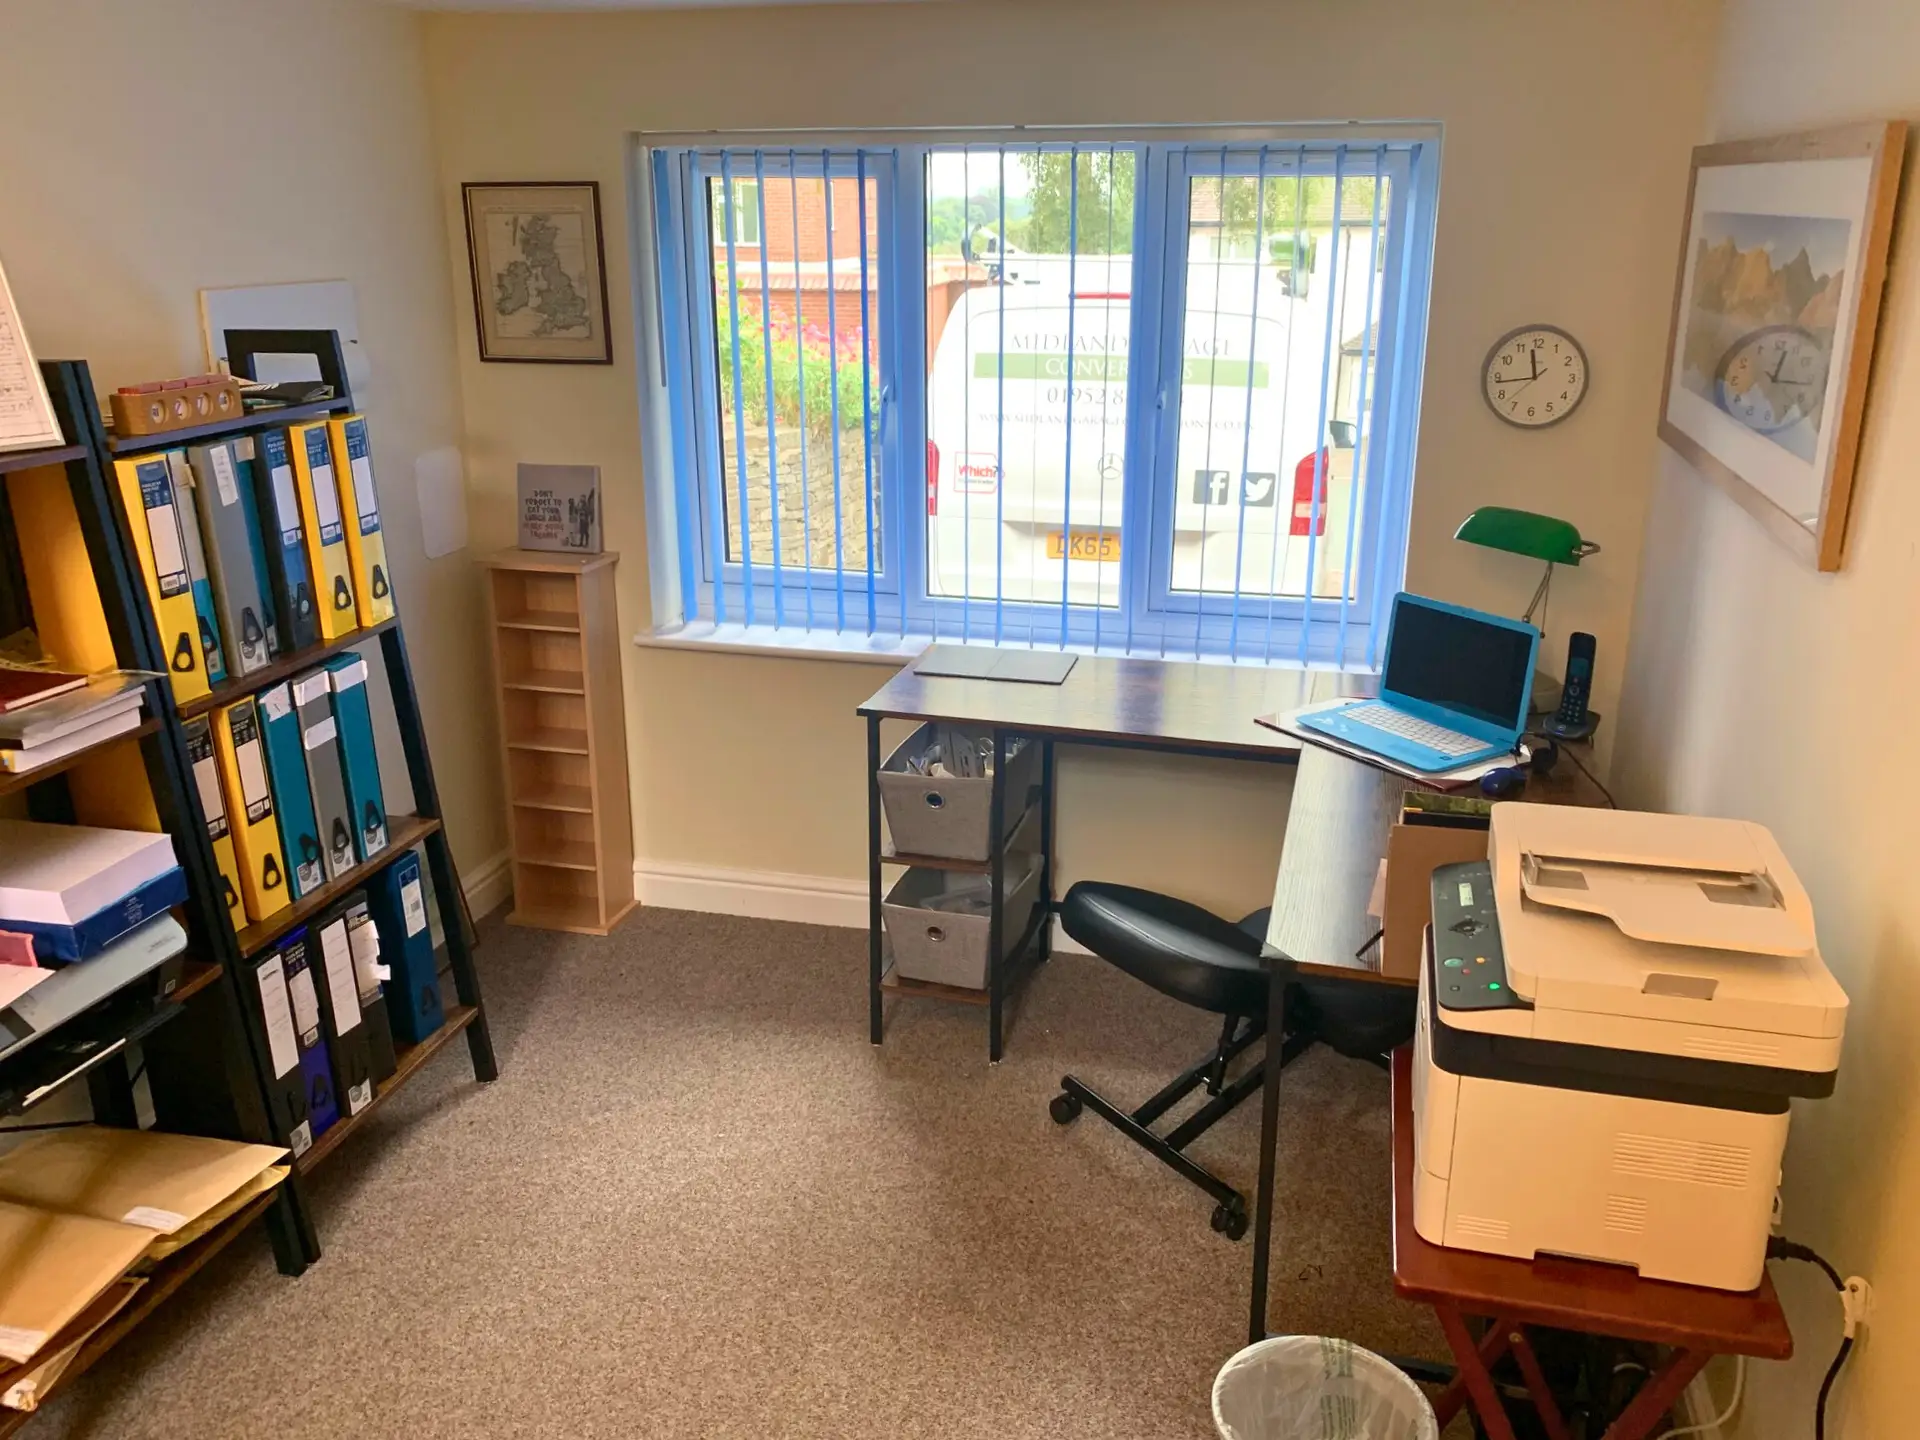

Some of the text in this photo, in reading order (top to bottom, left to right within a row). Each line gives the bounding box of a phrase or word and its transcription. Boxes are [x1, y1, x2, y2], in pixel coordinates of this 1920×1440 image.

[1516, 343, 1526, 353] 11
[1532, 338, 1545, 349] 12
[1553, 344, 1559, 354] 1
[1501, 354, 1513, 366] 10
[1564, 356, 1573, 367] 2
[1494, 372, 1502, 383] 9
[1568, 373, 1576, 384] 3
[1497, 389, 1506, 400] 8
[1560, 391, 1568, 400] 4
[1511, 401, 1518, 412] 7
[1527, 406, 1535, 417] 6
[1545, 402, 1554, 412] 5
